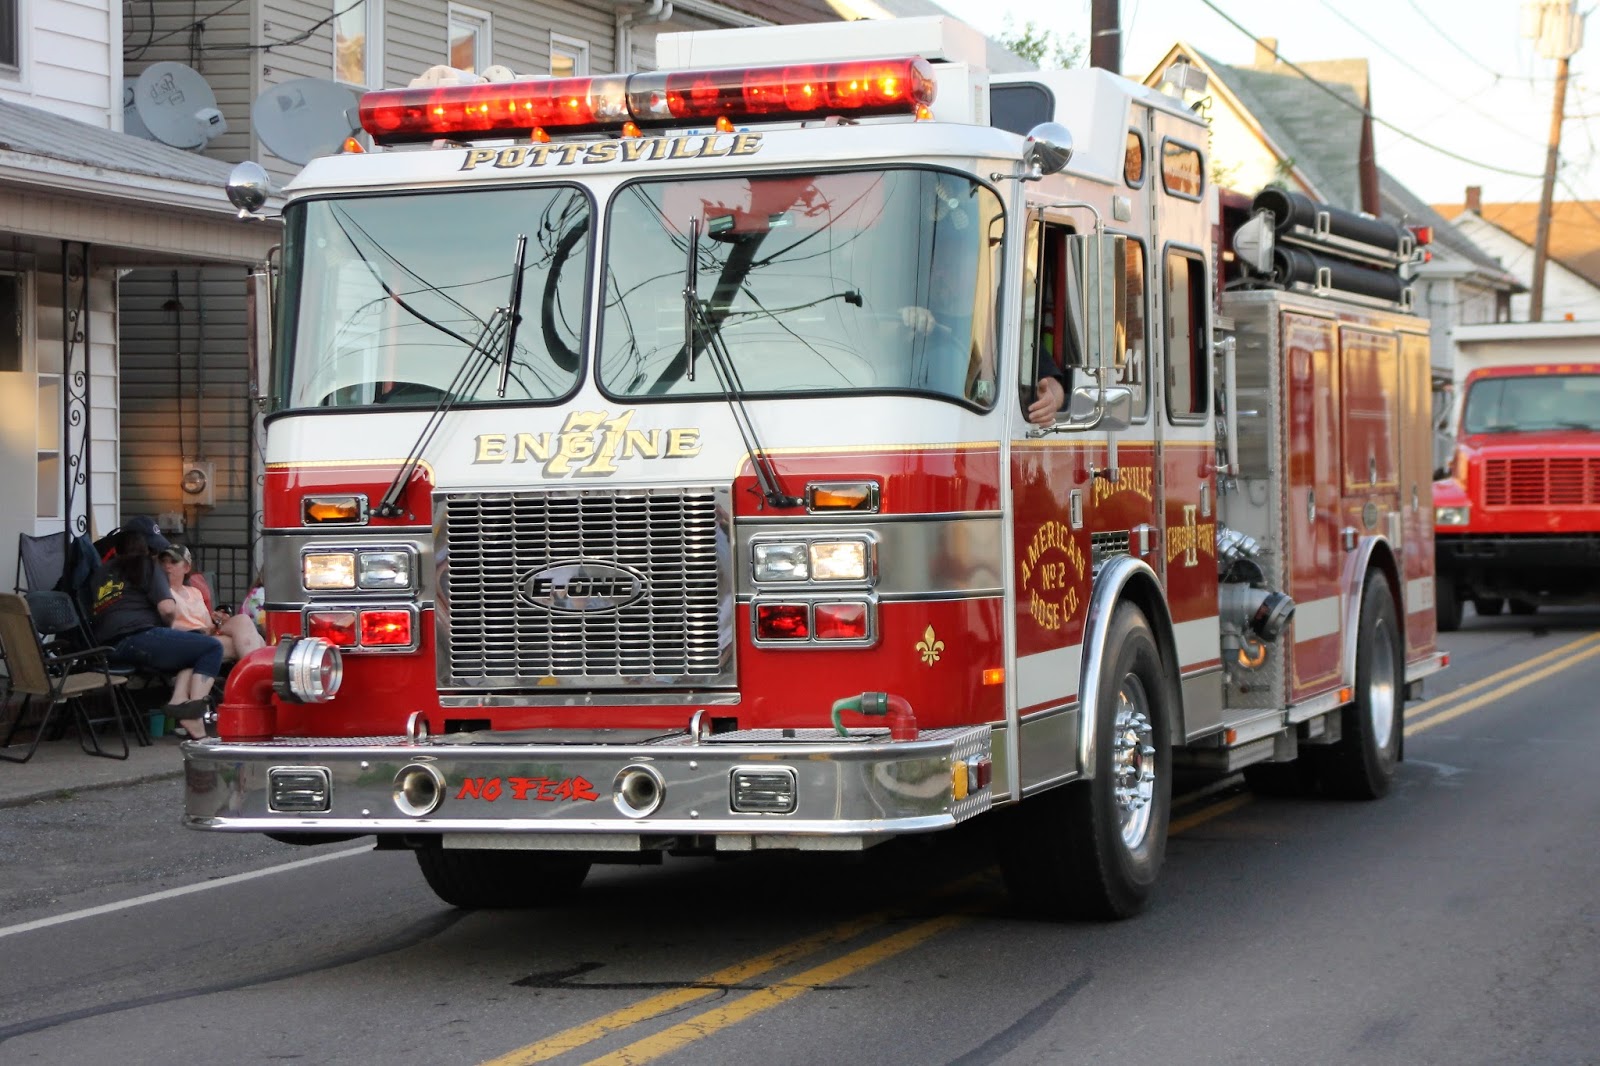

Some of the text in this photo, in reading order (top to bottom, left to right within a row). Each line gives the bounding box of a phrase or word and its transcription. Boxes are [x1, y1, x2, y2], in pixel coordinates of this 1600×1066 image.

[458, 133, 764, 171] POTTSVILLE
[471, 427, 704, 465] ENGINE
[542, 409, 636, 479] 71
[1022, 521, 1086, 591] AMERICAN
[1058, 562, 1066, 588] 2
[531, 577, 634, 598] E-ONE
[1030, 586, 1080, 630] HOSE CO.
[455, 775, 600, 802] NO FEAR
